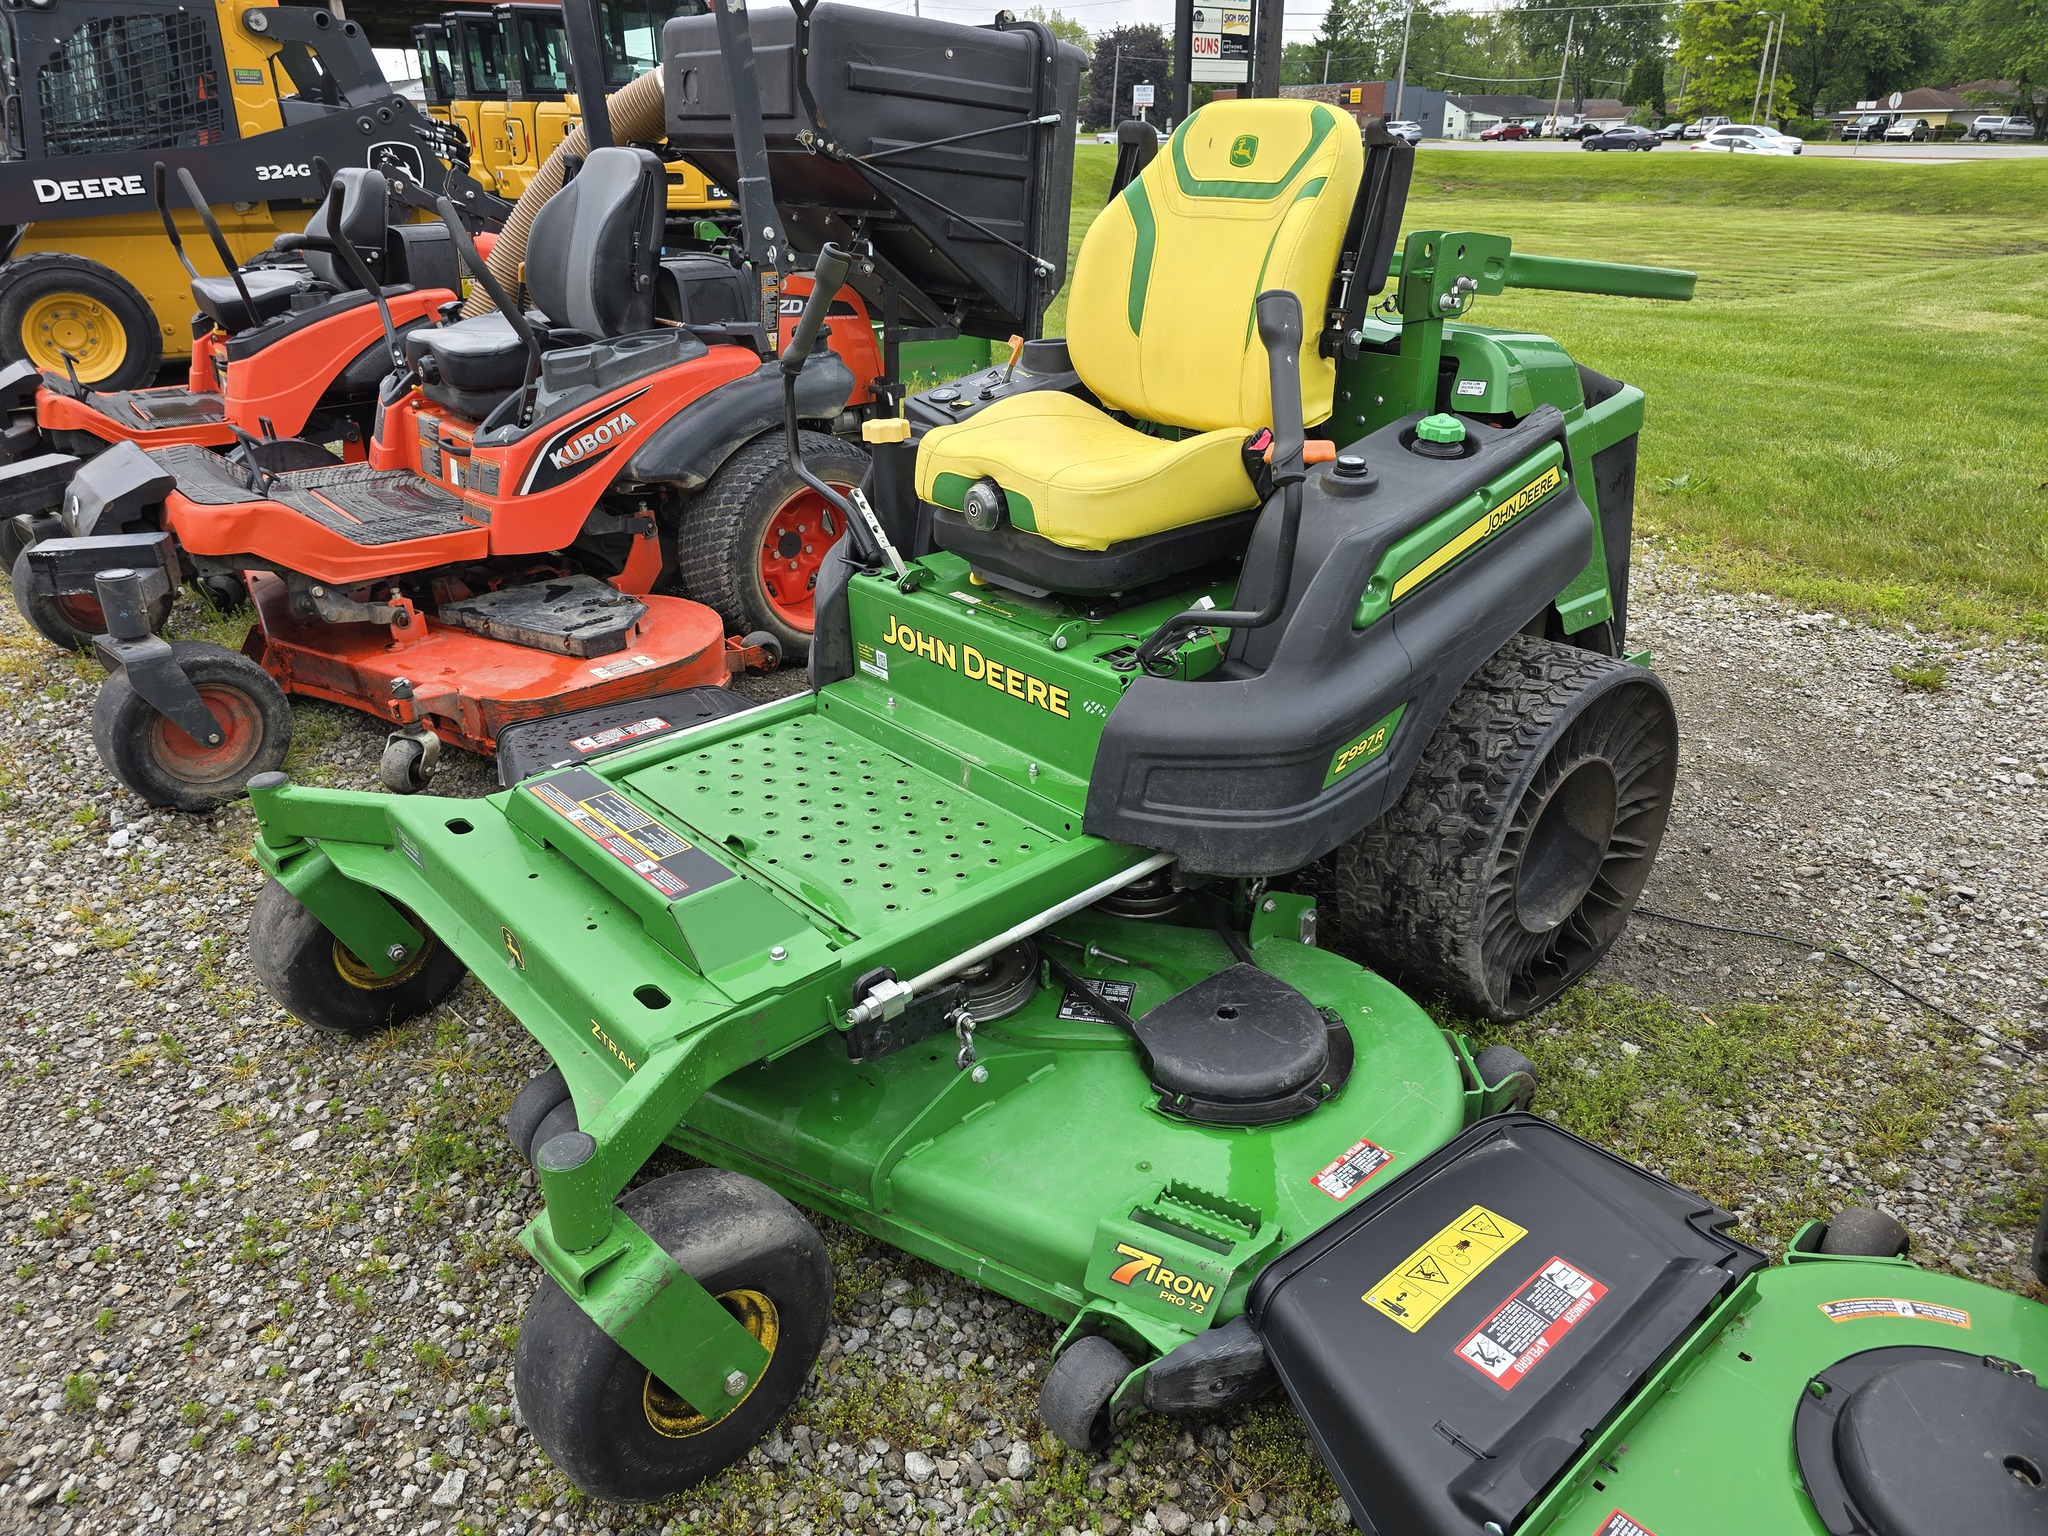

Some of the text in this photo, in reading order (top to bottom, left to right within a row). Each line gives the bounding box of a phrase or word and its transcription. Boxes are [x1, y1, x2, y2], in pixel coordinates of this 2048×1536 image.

[1224, 14, 1249, 23] SIGN PRO
[1193, 36, 1220, 55] GUNS
[255, 164, 311, 181] 324G
[32, 175, 146, 203] DEERE
[549, 412, 638, 471] KUBOTA
[1484, 474, 1555, 537] JOHN DEERE
[882, 614, 1071, 720] JOHN DEERE
[1334, 726, 1386, 775] Z997R
[590, 1017, 637, 1075] ZTRAK
[1159, 1290, 1206, 1315] PRO 72
[1562, 1299, 1592, 1324] DANGER
[1513, 1340, 1545, 1373] PELIGRO
